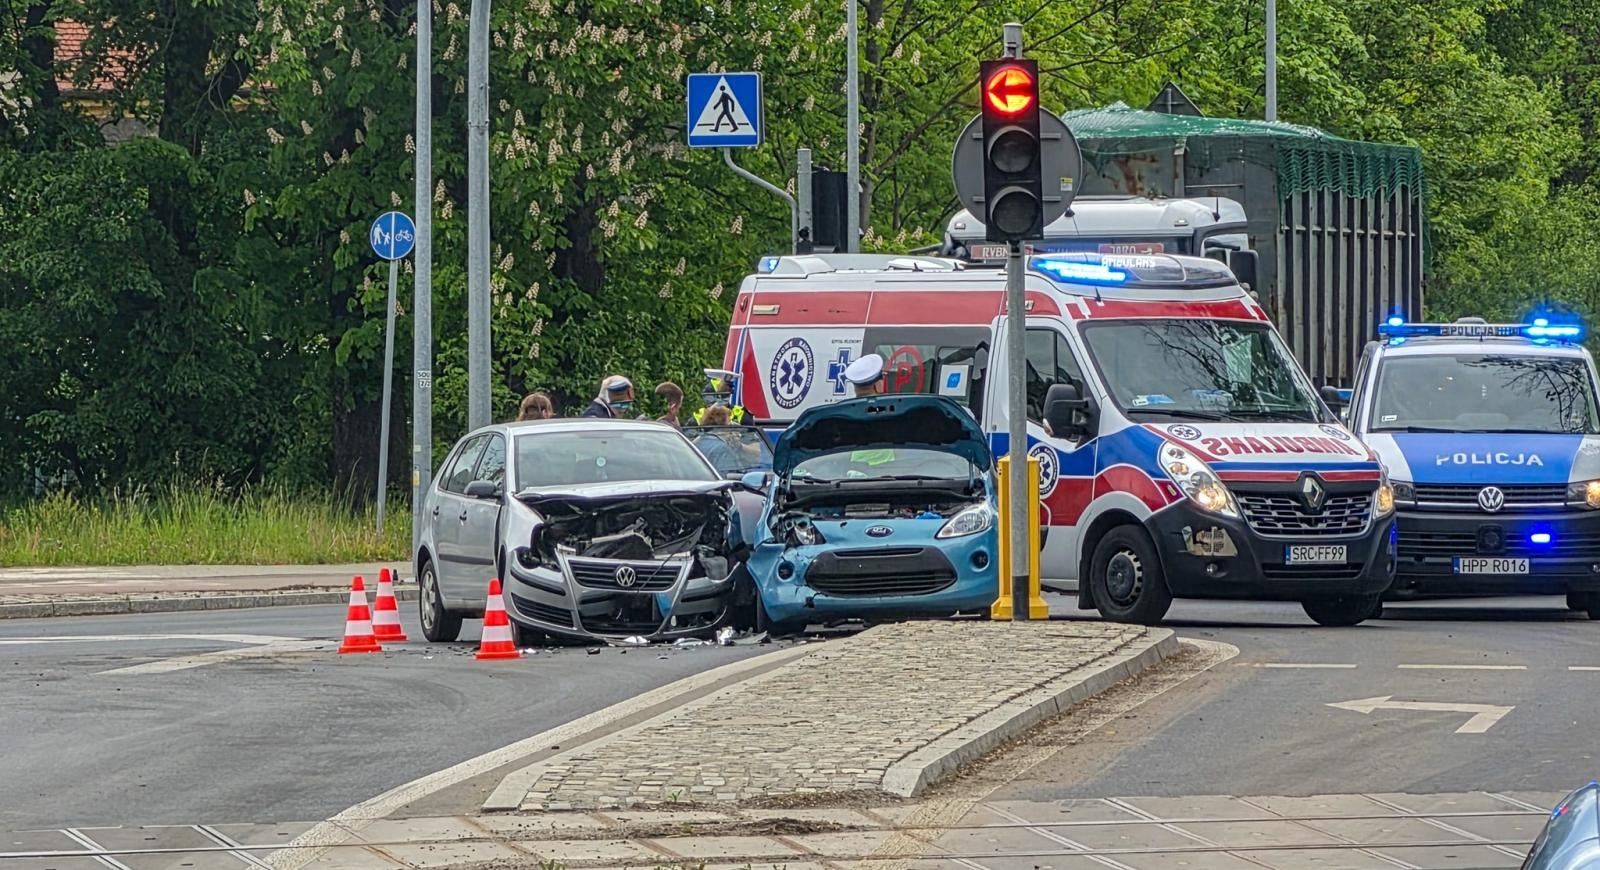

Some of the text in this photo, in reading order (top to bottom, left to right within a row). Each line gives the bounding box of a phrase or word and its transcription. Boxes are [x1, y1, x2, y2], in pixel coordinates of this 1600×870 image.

[982, 247, 1008, 258] RYBN
[1450, 326, 1494, 336] POLICJA
[1436, 452, 1543, 466] POLICJA
[1462, 559, 1488, 573] HPP
